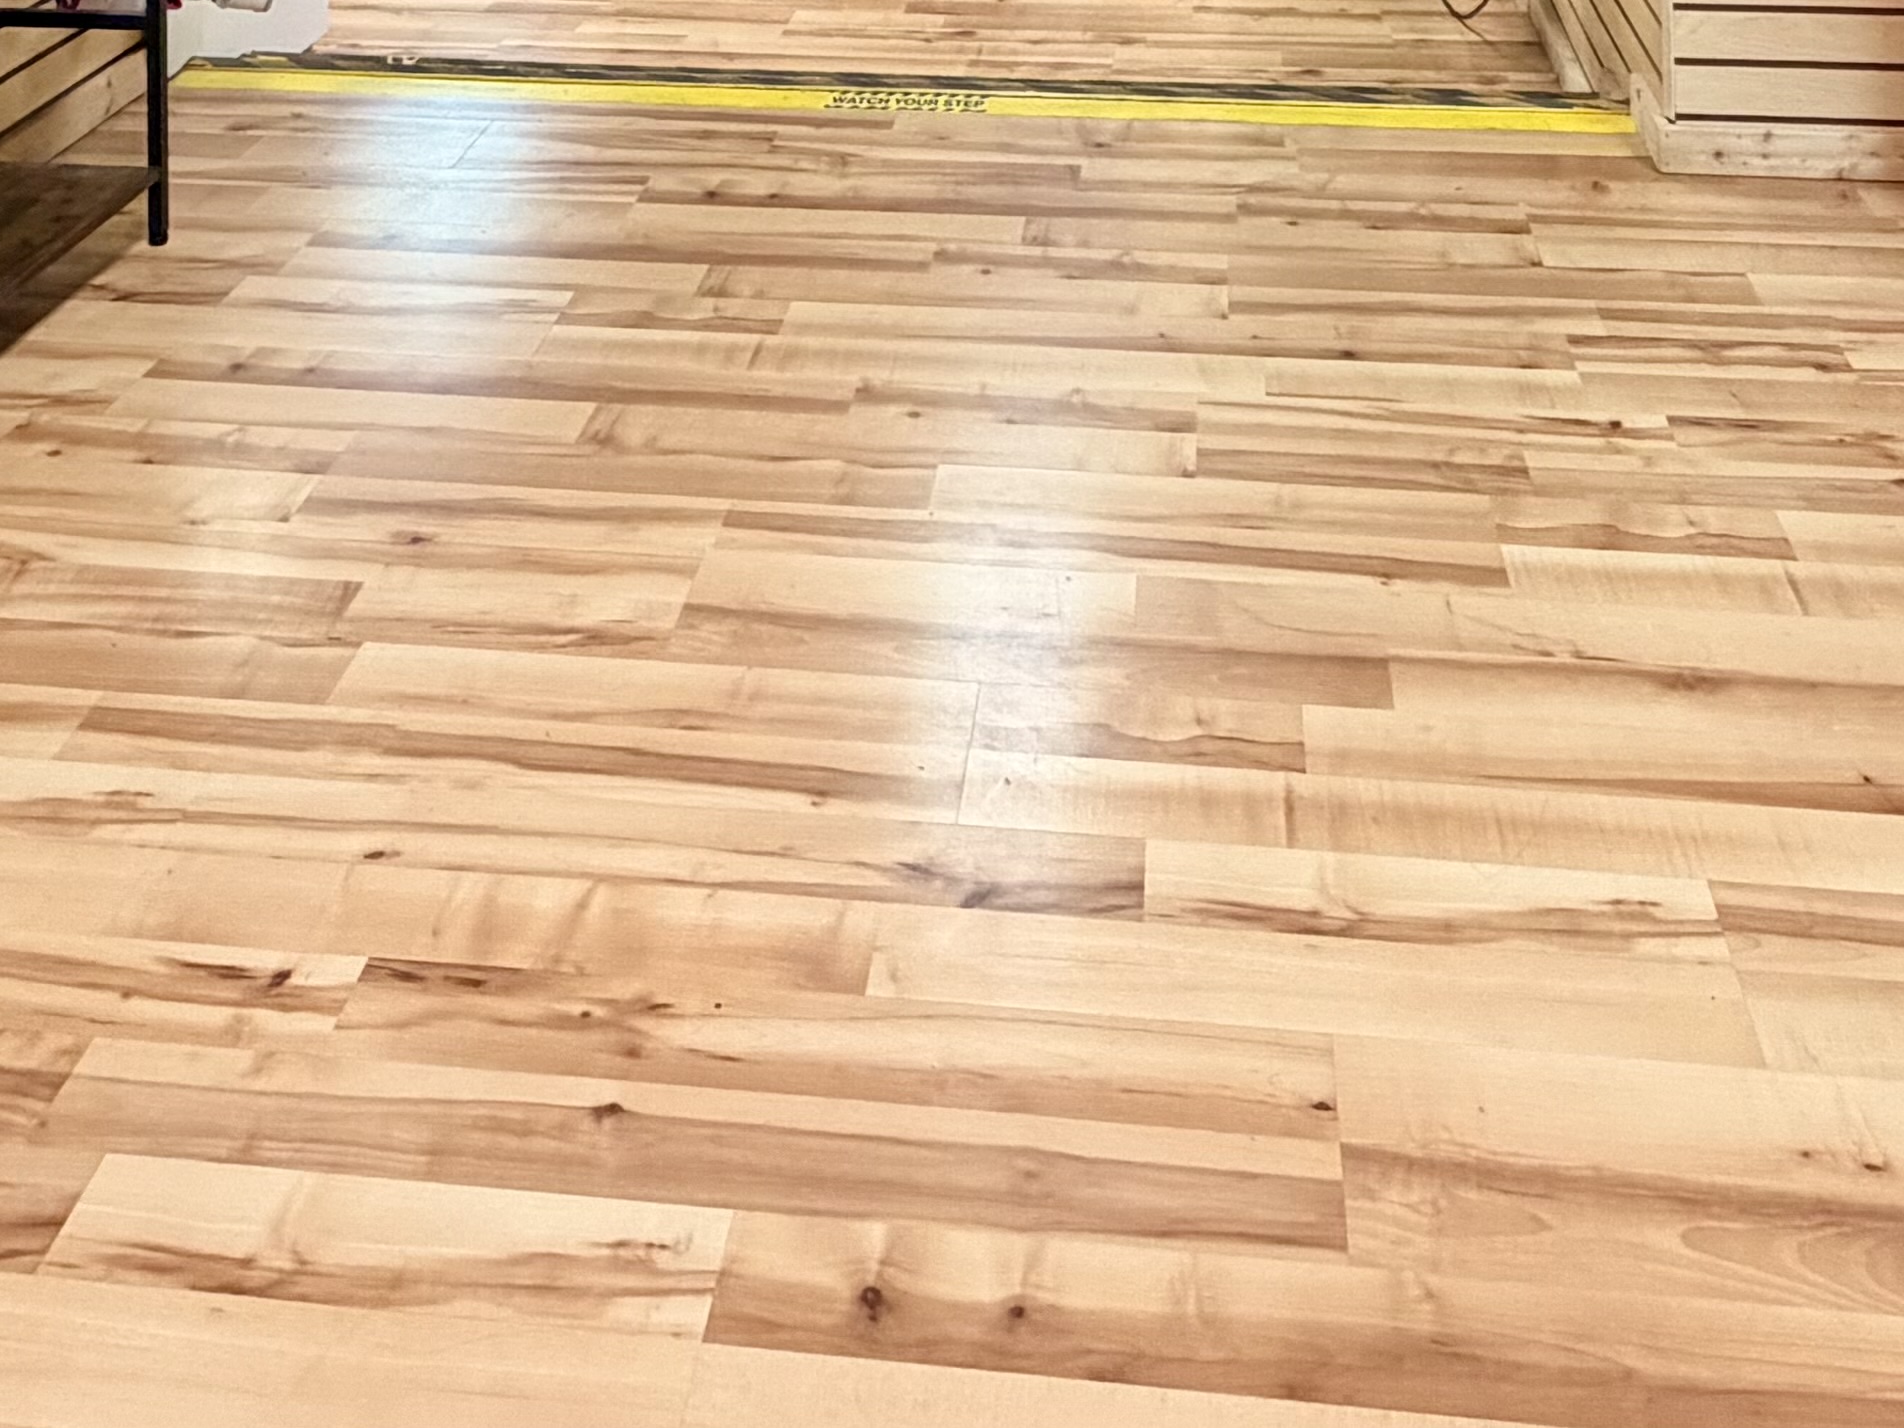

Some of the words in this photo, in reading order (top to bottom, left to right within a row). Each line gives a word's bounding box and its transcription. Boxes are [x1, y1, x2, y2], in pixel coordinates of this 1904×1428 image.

[831, 96, 891, 105] WATCH
[895, 98, 939, 106] YOUR
[943, 99, 986, 108] STEP
